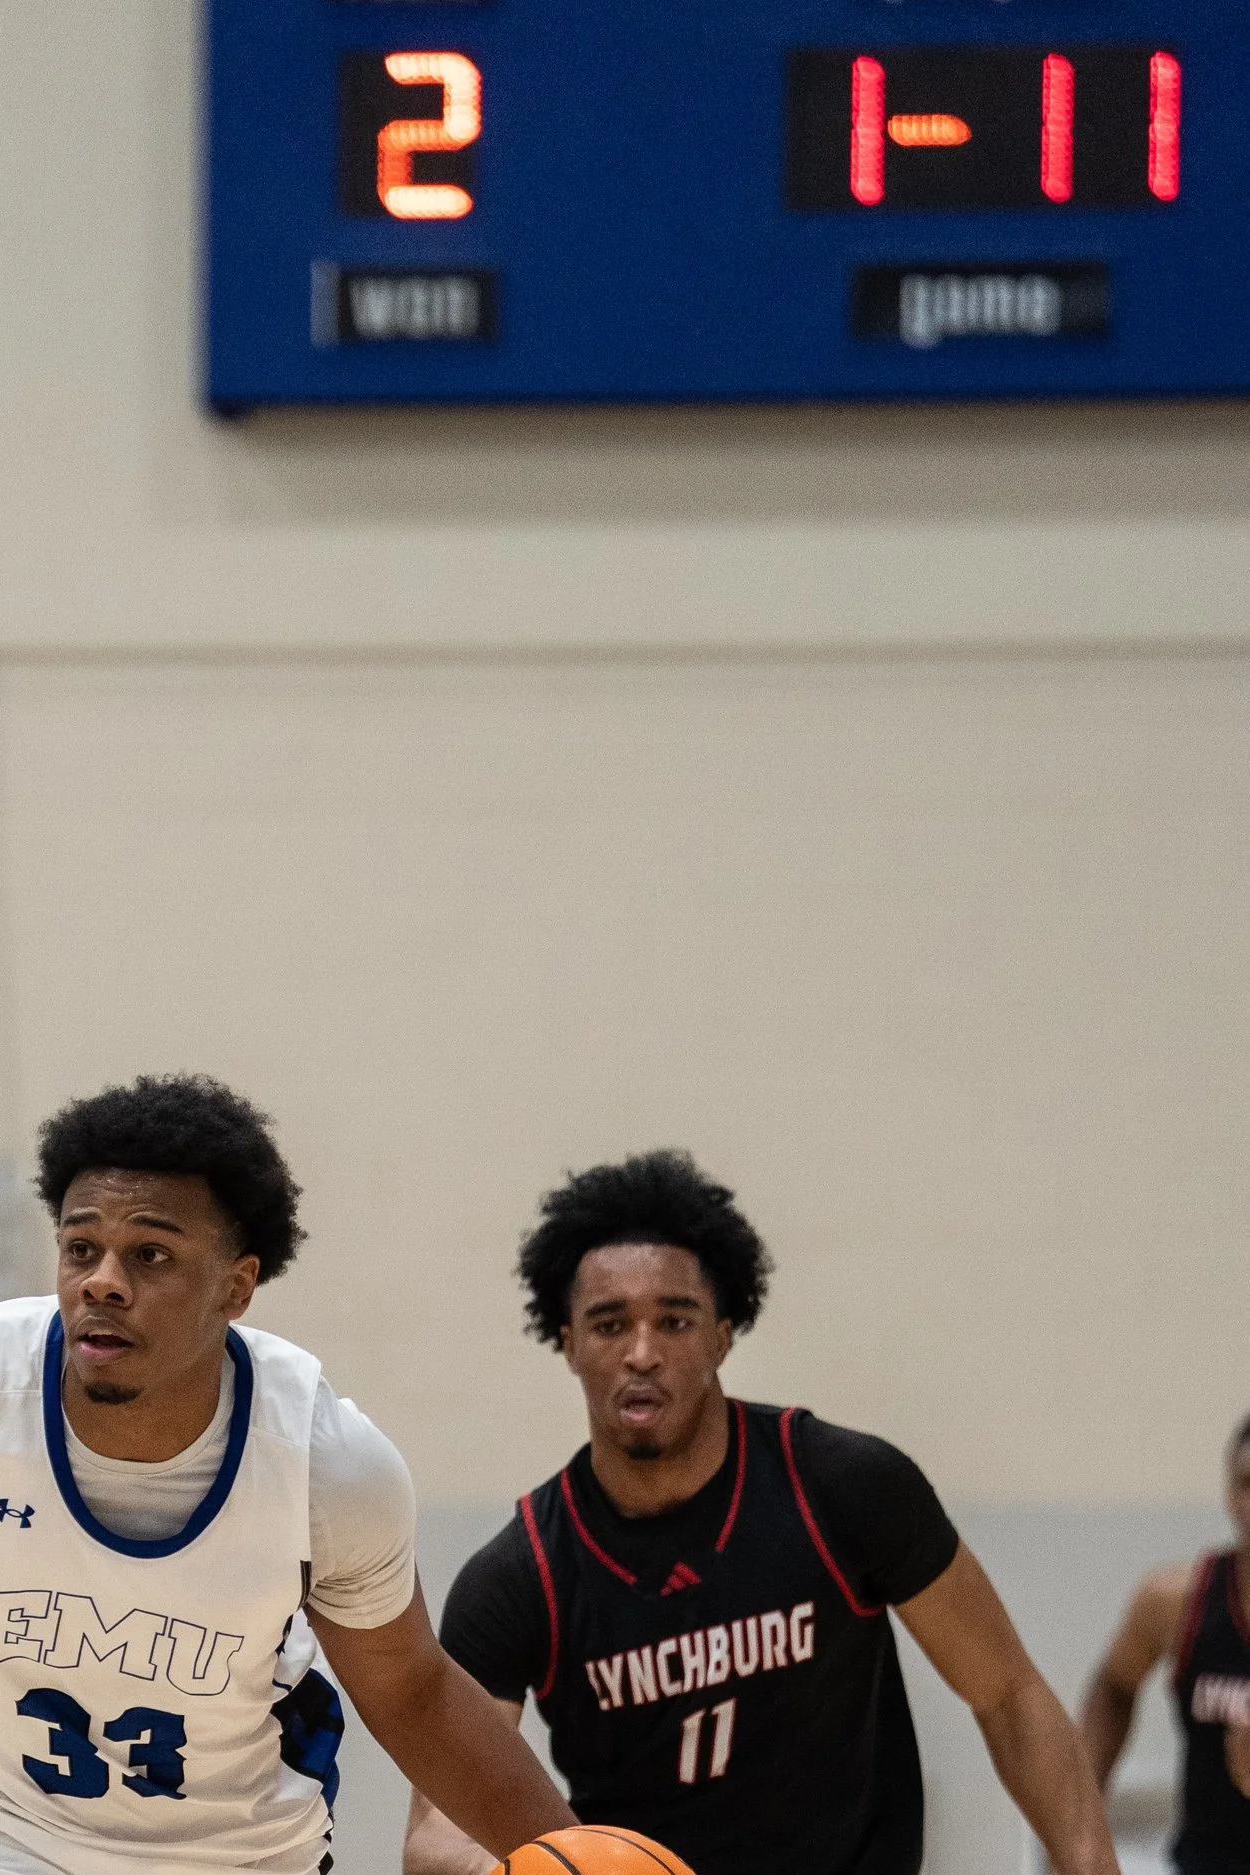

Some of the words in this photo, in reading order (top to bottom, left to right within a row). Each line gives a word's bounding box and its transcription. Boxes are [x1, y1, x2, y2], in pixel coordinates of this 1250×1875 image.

[377, 52, 482, 220] 2
[14, 1687, 187, 1800] 33
[677, 1696, 738, 1786] 11
